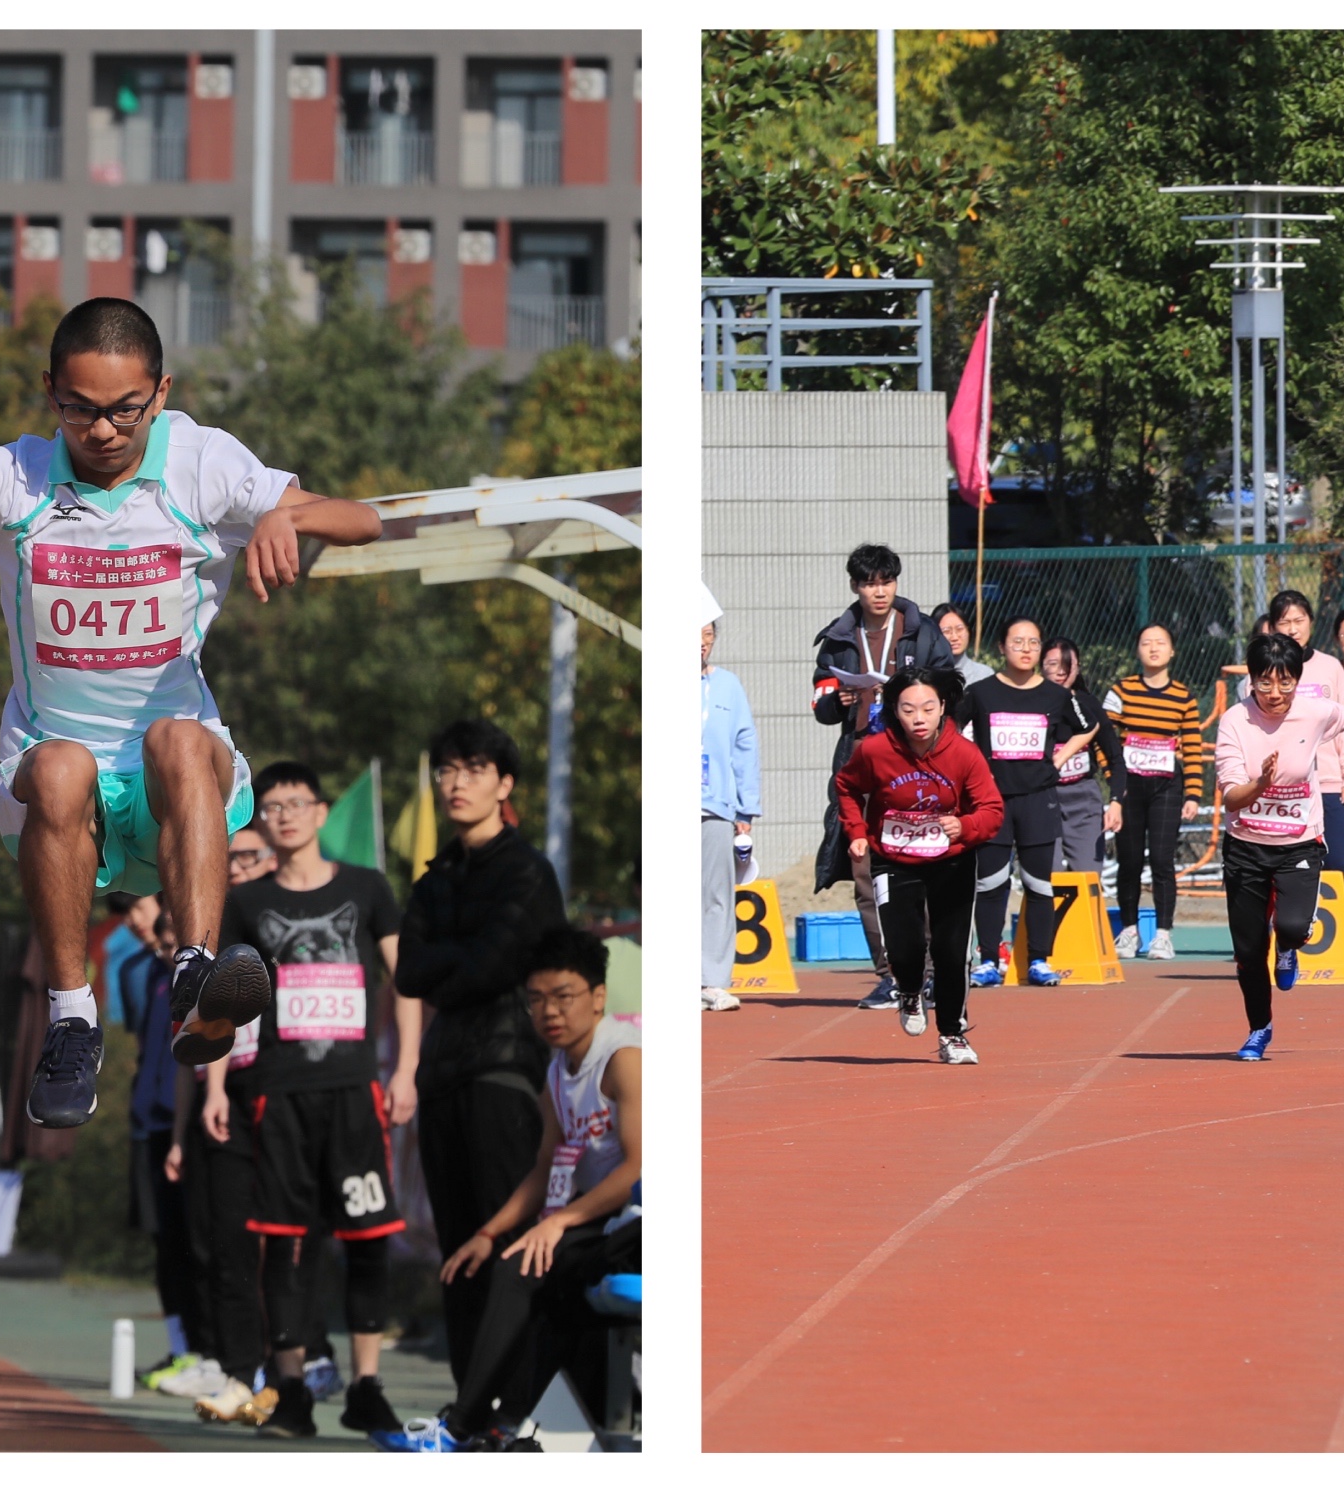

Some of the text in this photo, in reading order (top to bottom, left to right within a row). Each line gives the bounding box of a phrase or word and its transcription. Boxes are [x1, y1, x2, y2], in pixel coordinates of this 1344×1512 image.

[47, 566, 167, 584] 第六十二届田径运动会
[50, 596, 167, 637] 0471
[997, 731, 1040, 747] 0658
[1064, 756, 1083, 772] 16
[735, 890, 772, 965] 8
[288, 995, 355, 1019] 0235
[342, 1170, 387, 1217] 30
